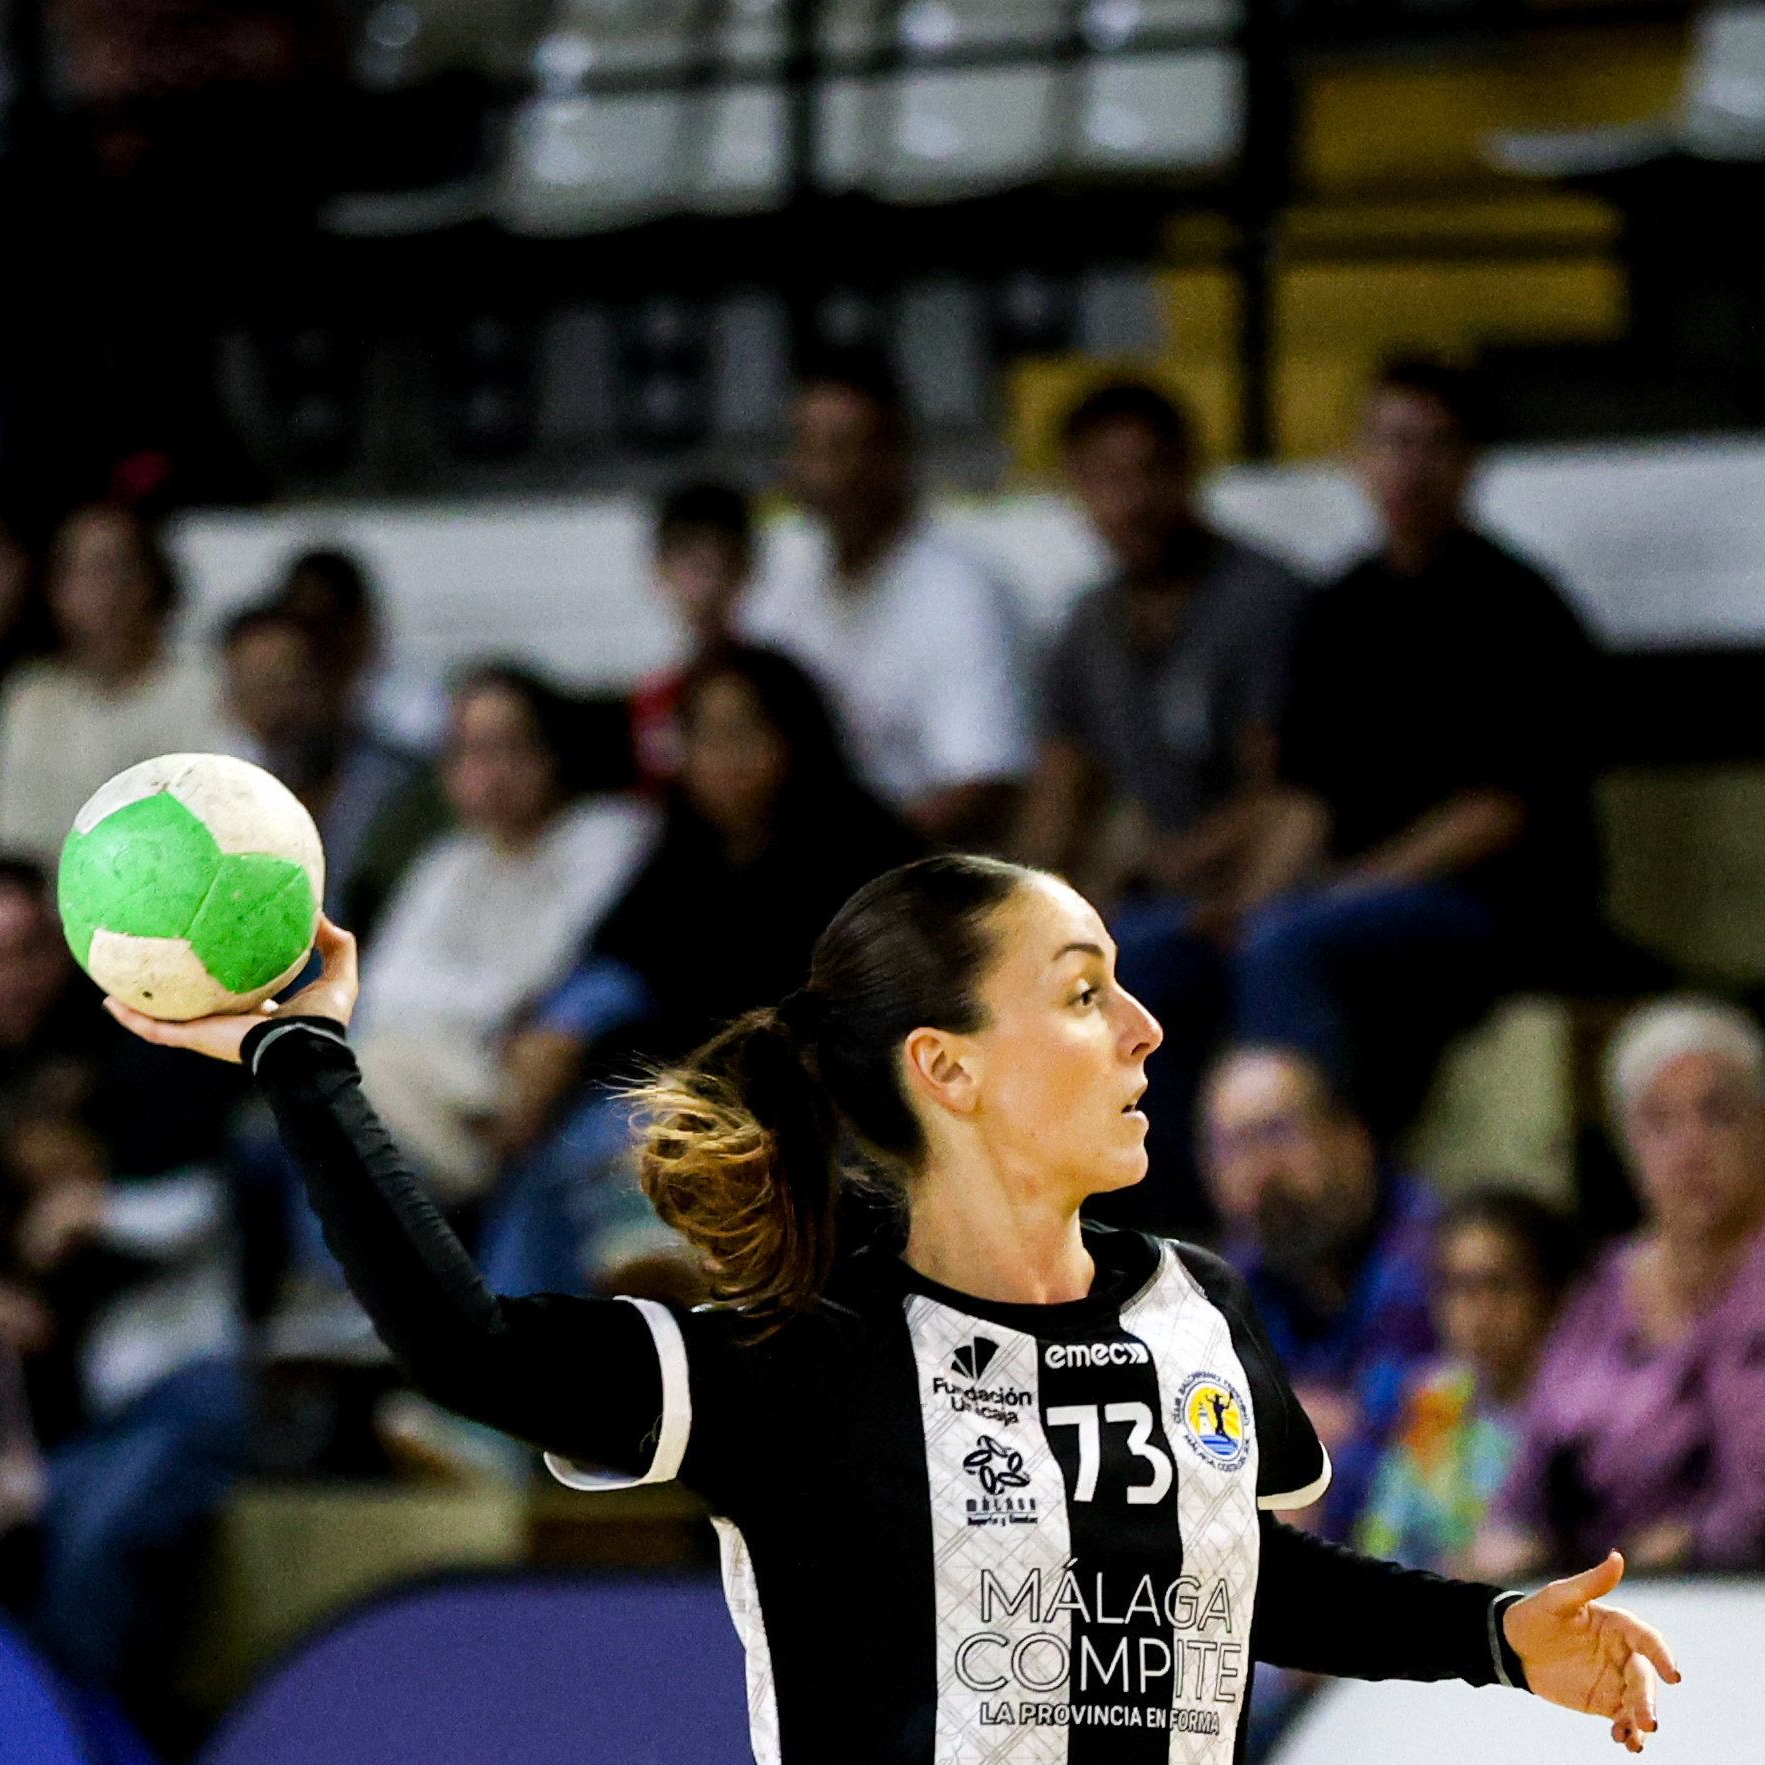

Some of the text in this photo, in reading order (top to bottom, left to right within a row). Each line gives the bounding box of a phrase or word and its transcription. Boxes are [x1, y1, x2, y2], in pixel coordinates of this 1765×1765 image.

[1046, 1401, 1173, 1505] 73
[981, 1557, 1232, 1634] MÁLAGA
[955, 1631, 1242, 1703] COMPITE
[979, 1701, 1221, 1736] LA PROVINCIA EN FORMA
